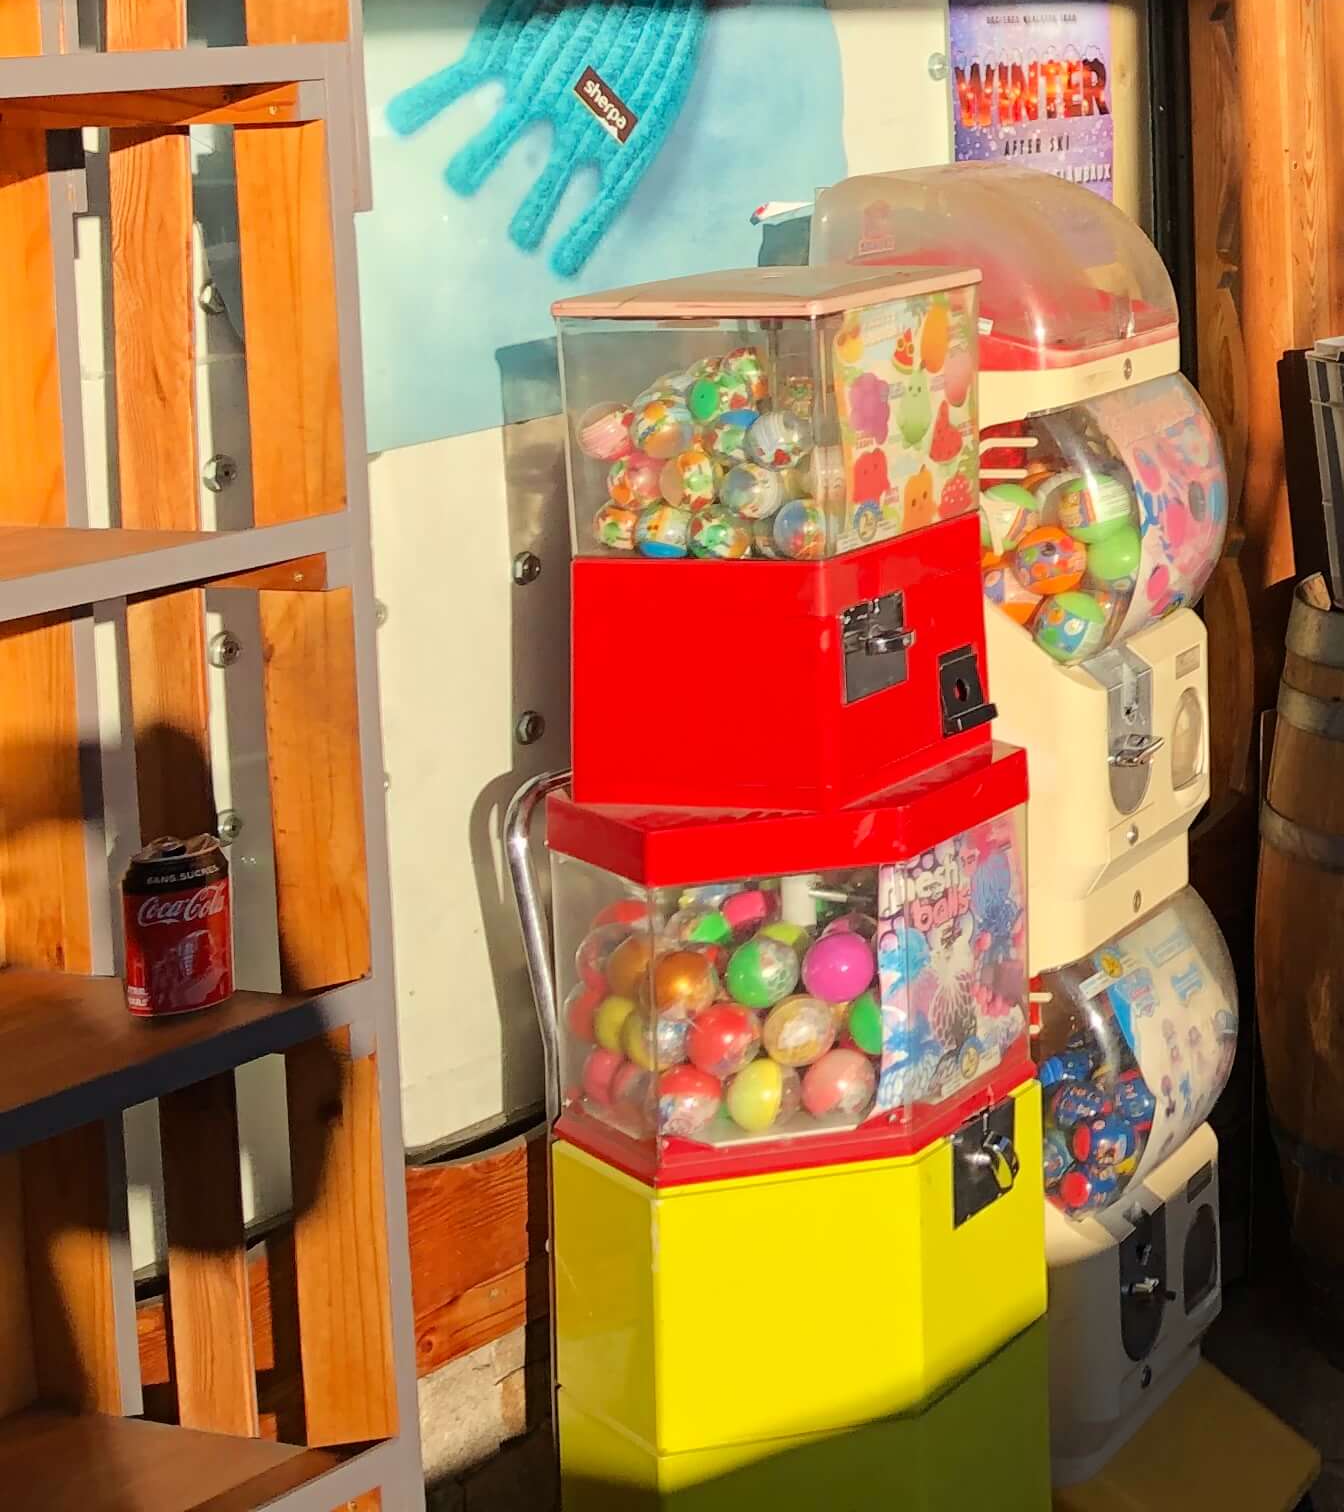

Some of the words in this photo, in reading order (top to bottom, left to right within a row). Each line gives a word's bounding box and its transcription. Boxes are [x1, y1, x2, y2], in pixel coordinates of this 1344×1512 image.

[583, 80, 627, 130] sherpa
[954, 57, 1111, 129] WINTER
[1003, 138, 1041, 157] AFTER
[1050, 135, 1071, 153] SKI
